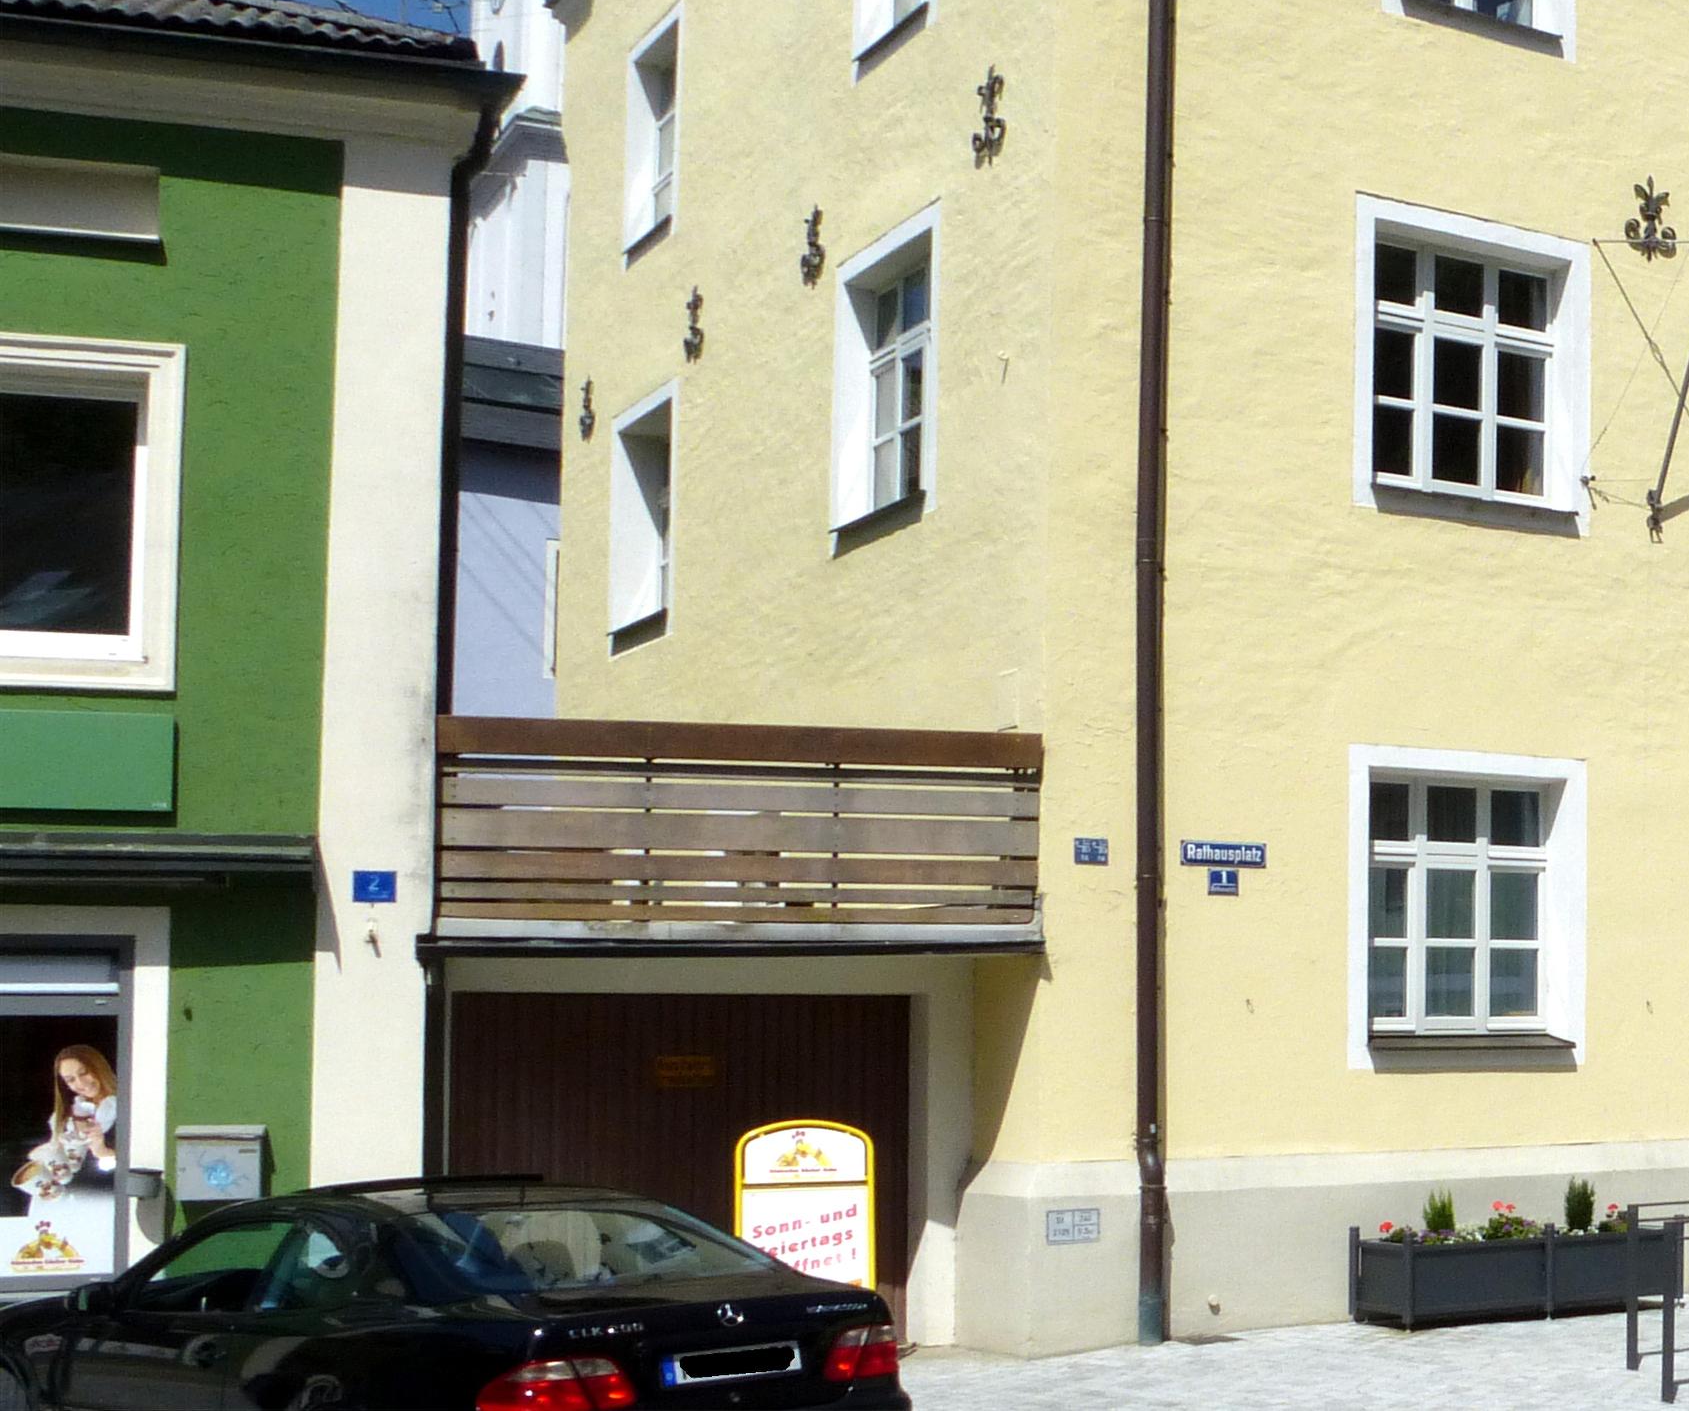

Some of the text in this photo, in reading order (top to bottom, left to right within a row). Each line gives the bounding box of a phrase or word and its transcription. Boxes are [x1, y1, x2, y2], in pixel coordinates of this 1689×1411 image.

[1187, 843, 1262, 864] Rathausplatz
[368, 874, 380, 891] 2
[1220, 870, 1228, 885] 1
[752, 1203, 858, 1239] Sonn- und
